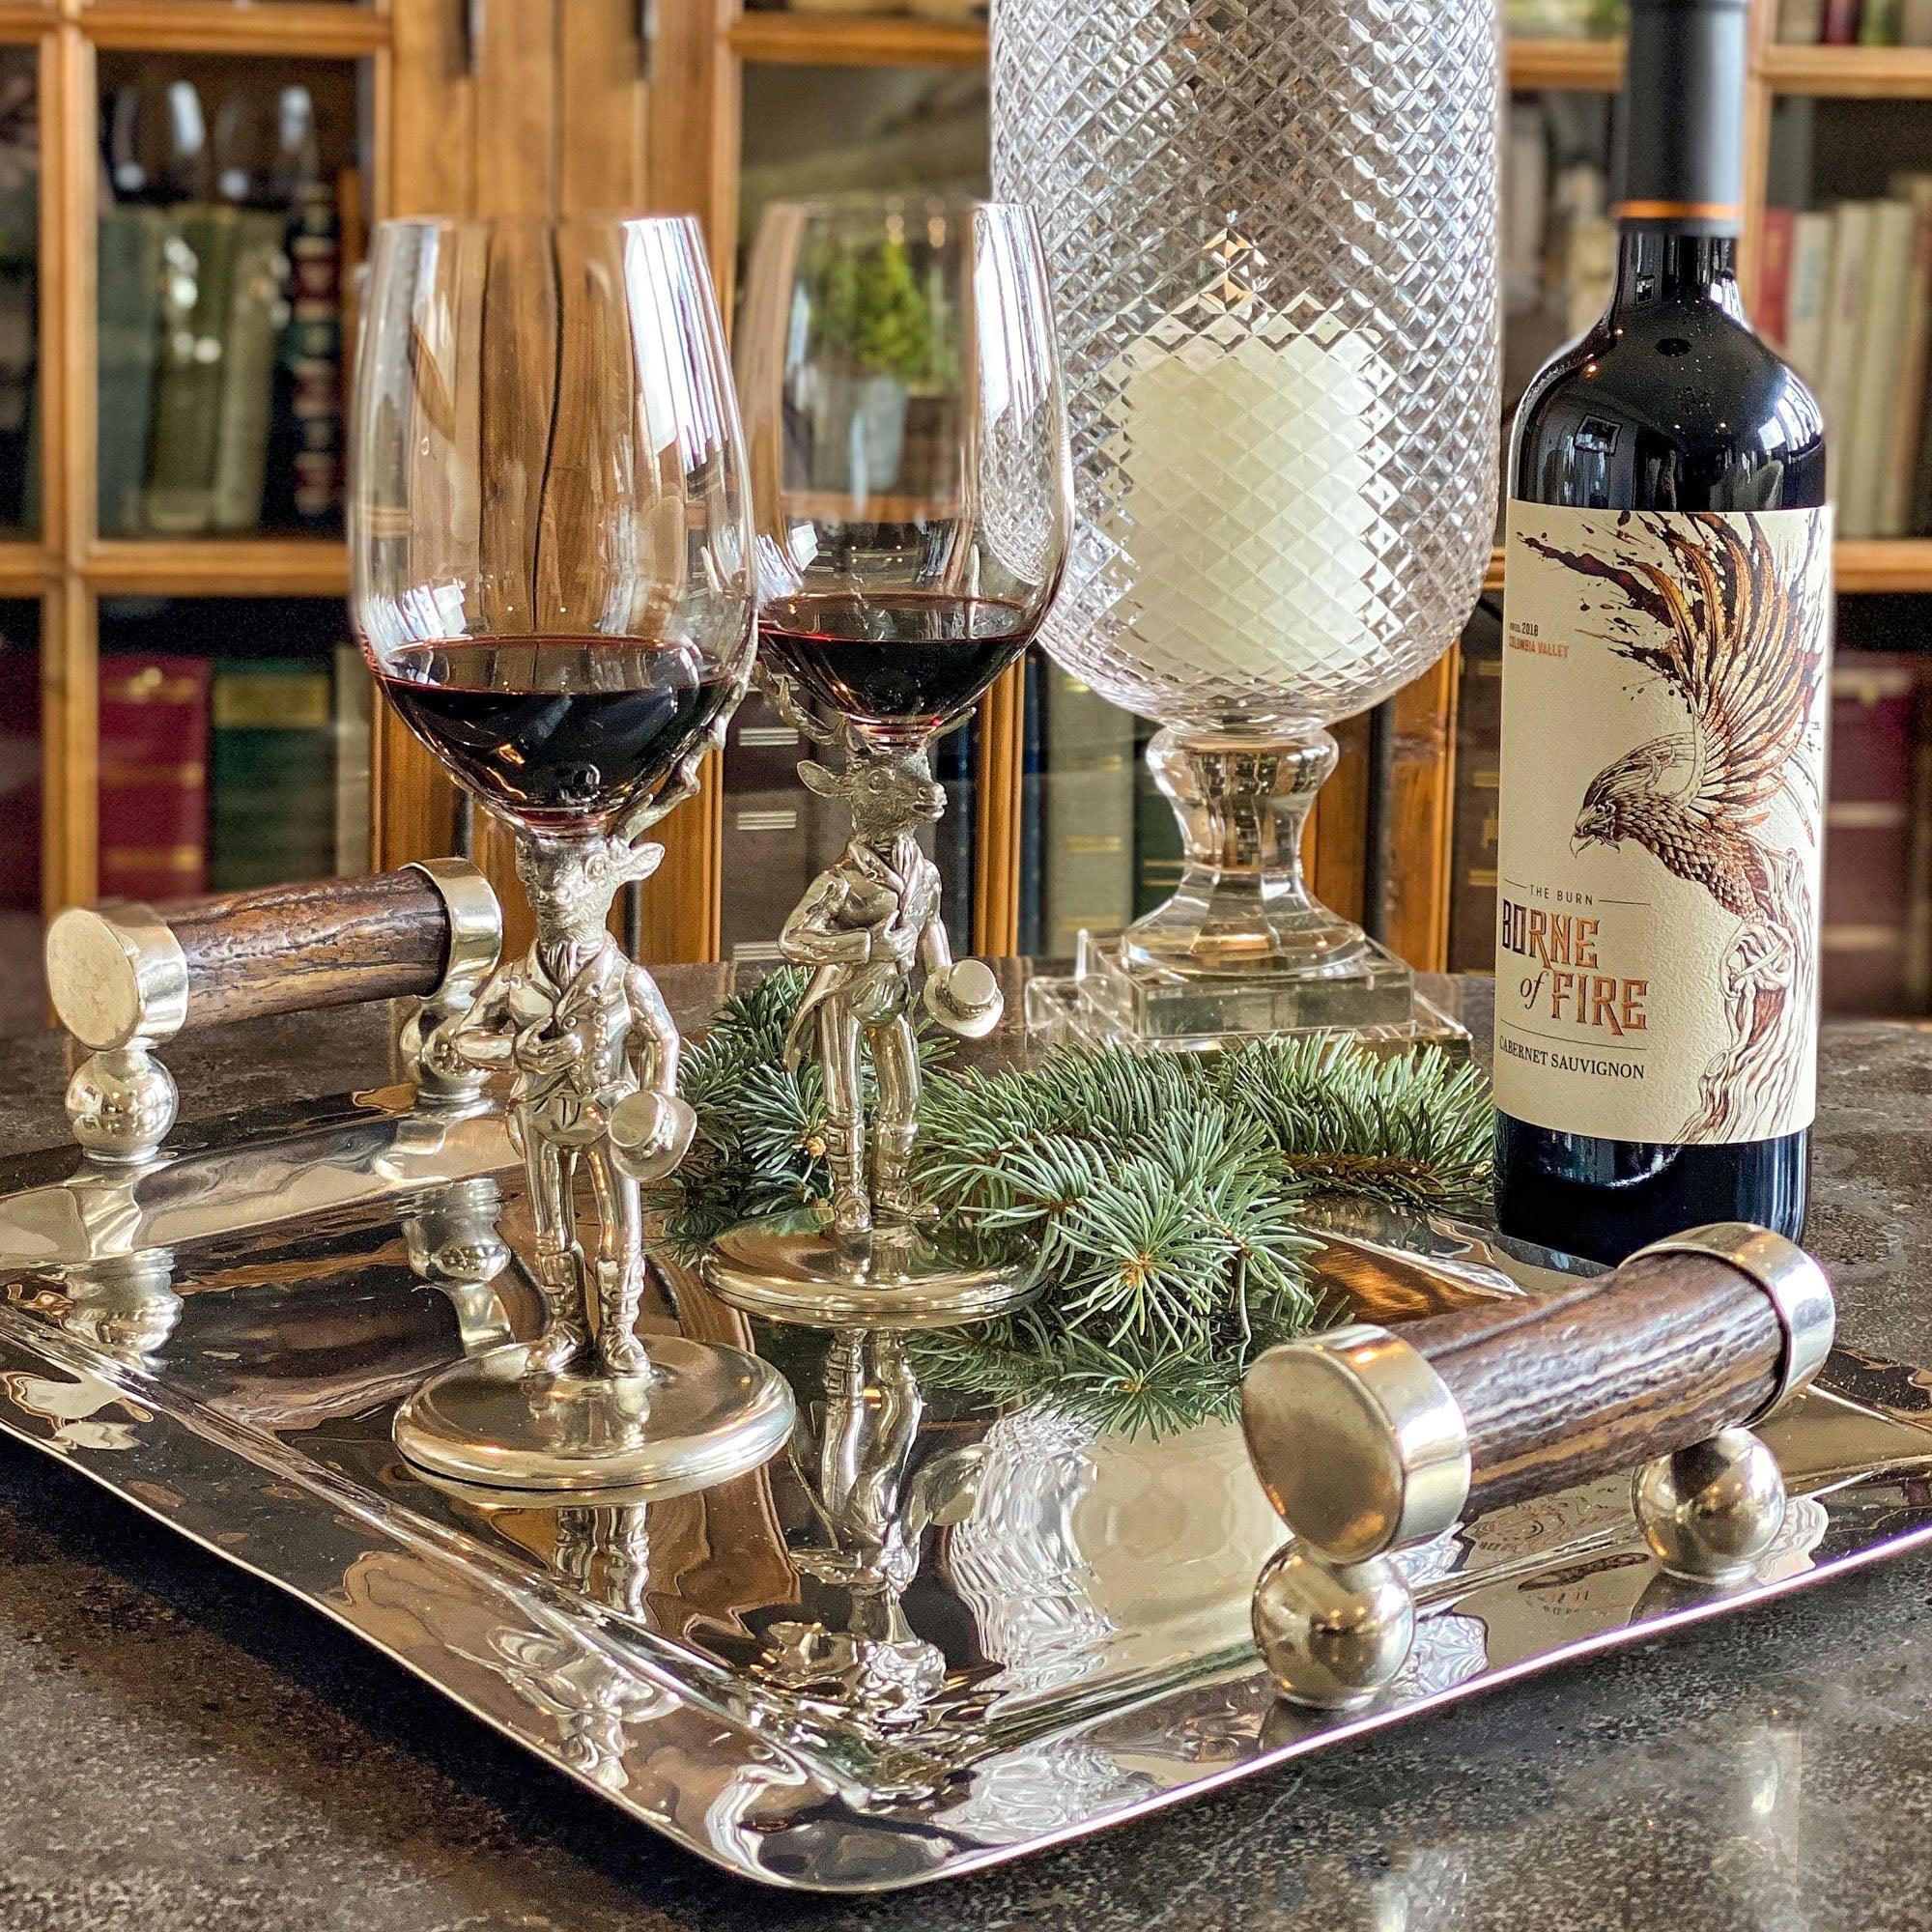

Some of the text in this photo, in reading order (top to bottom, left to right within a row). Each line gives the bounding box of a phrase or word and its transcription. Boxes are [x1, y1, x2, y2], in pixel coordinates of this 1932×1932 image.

[1537, 641, 1569, 658] VALLEY
[1529, 884, 1593, 905] THE BURN
[1502, 898, 1601, 971] BORNE
[1520, 969, 1648, 1037] of FIRE
[1499, 1036, 1644, 1079] CABERNET SAUVIGNON
